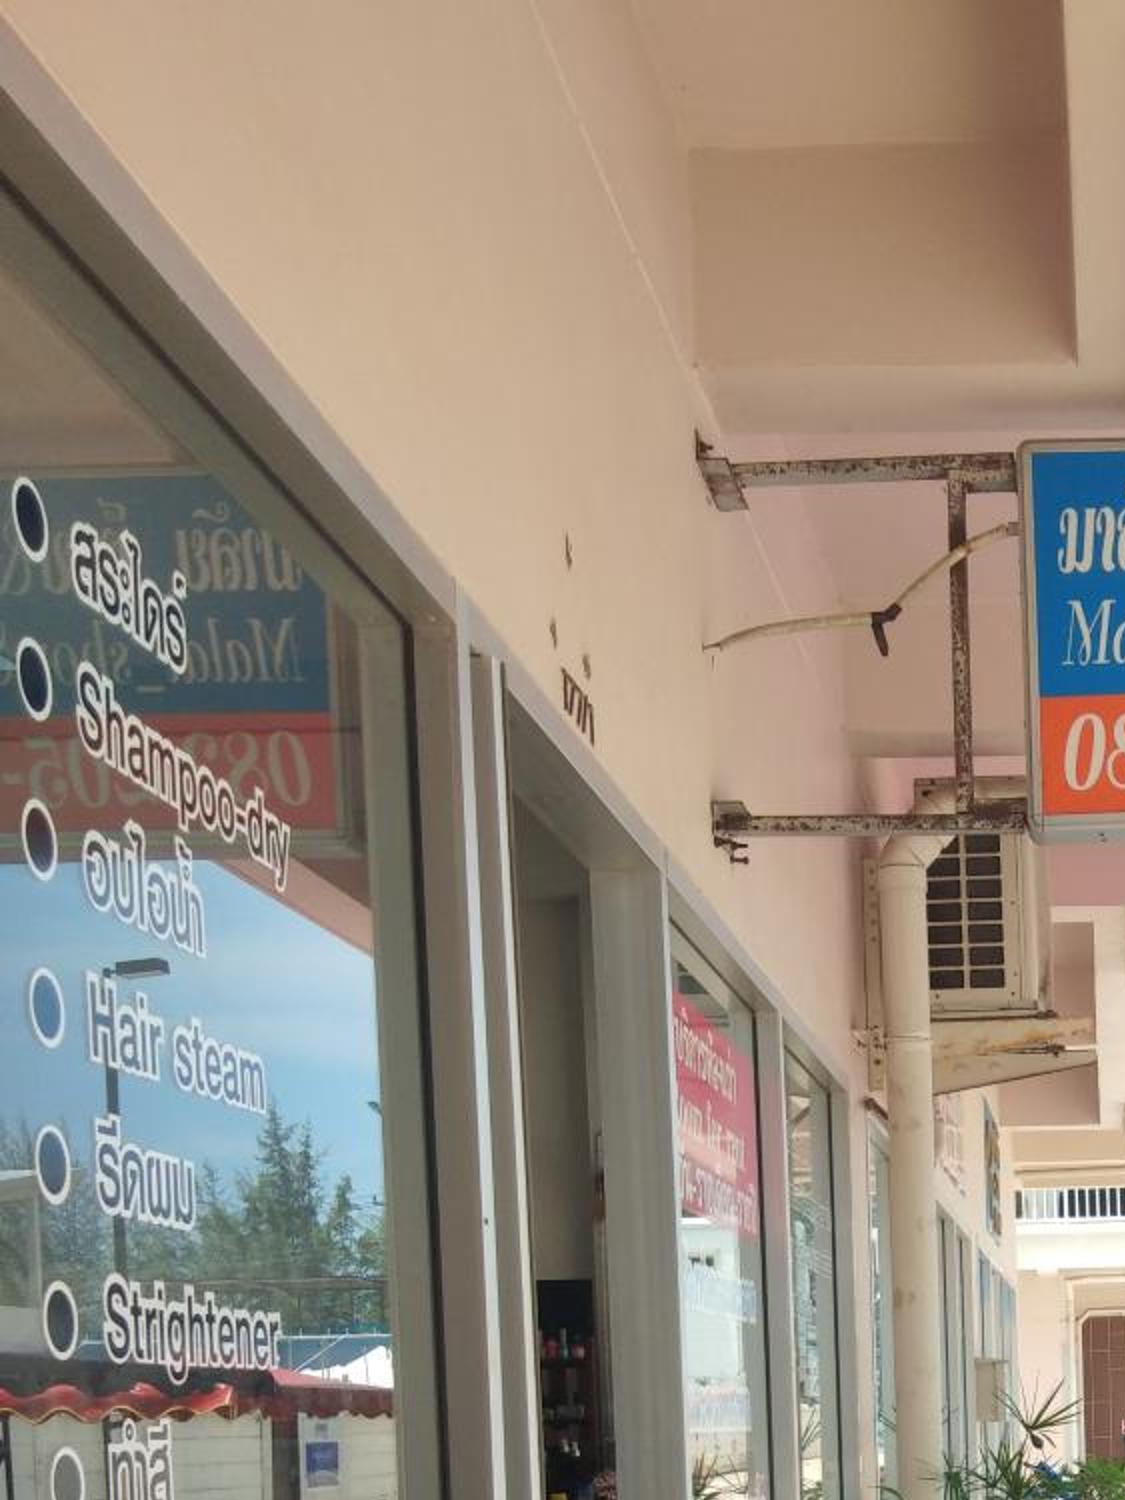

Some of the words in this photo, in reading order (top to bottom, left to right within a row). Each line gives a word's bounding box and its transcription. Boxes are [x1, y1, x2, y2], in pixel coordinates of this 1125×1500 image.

[76, 660, 291, 894] Shampoo-dry
[83, 818, 207, 958] อบไอน้ำ
[86, 970, 164, 1082] Hair
[173, 1016, 267, 1115] steam
[94, 1113, 196, 1231] รีดผม
[104, 1273, 282, 1385] Strightener
